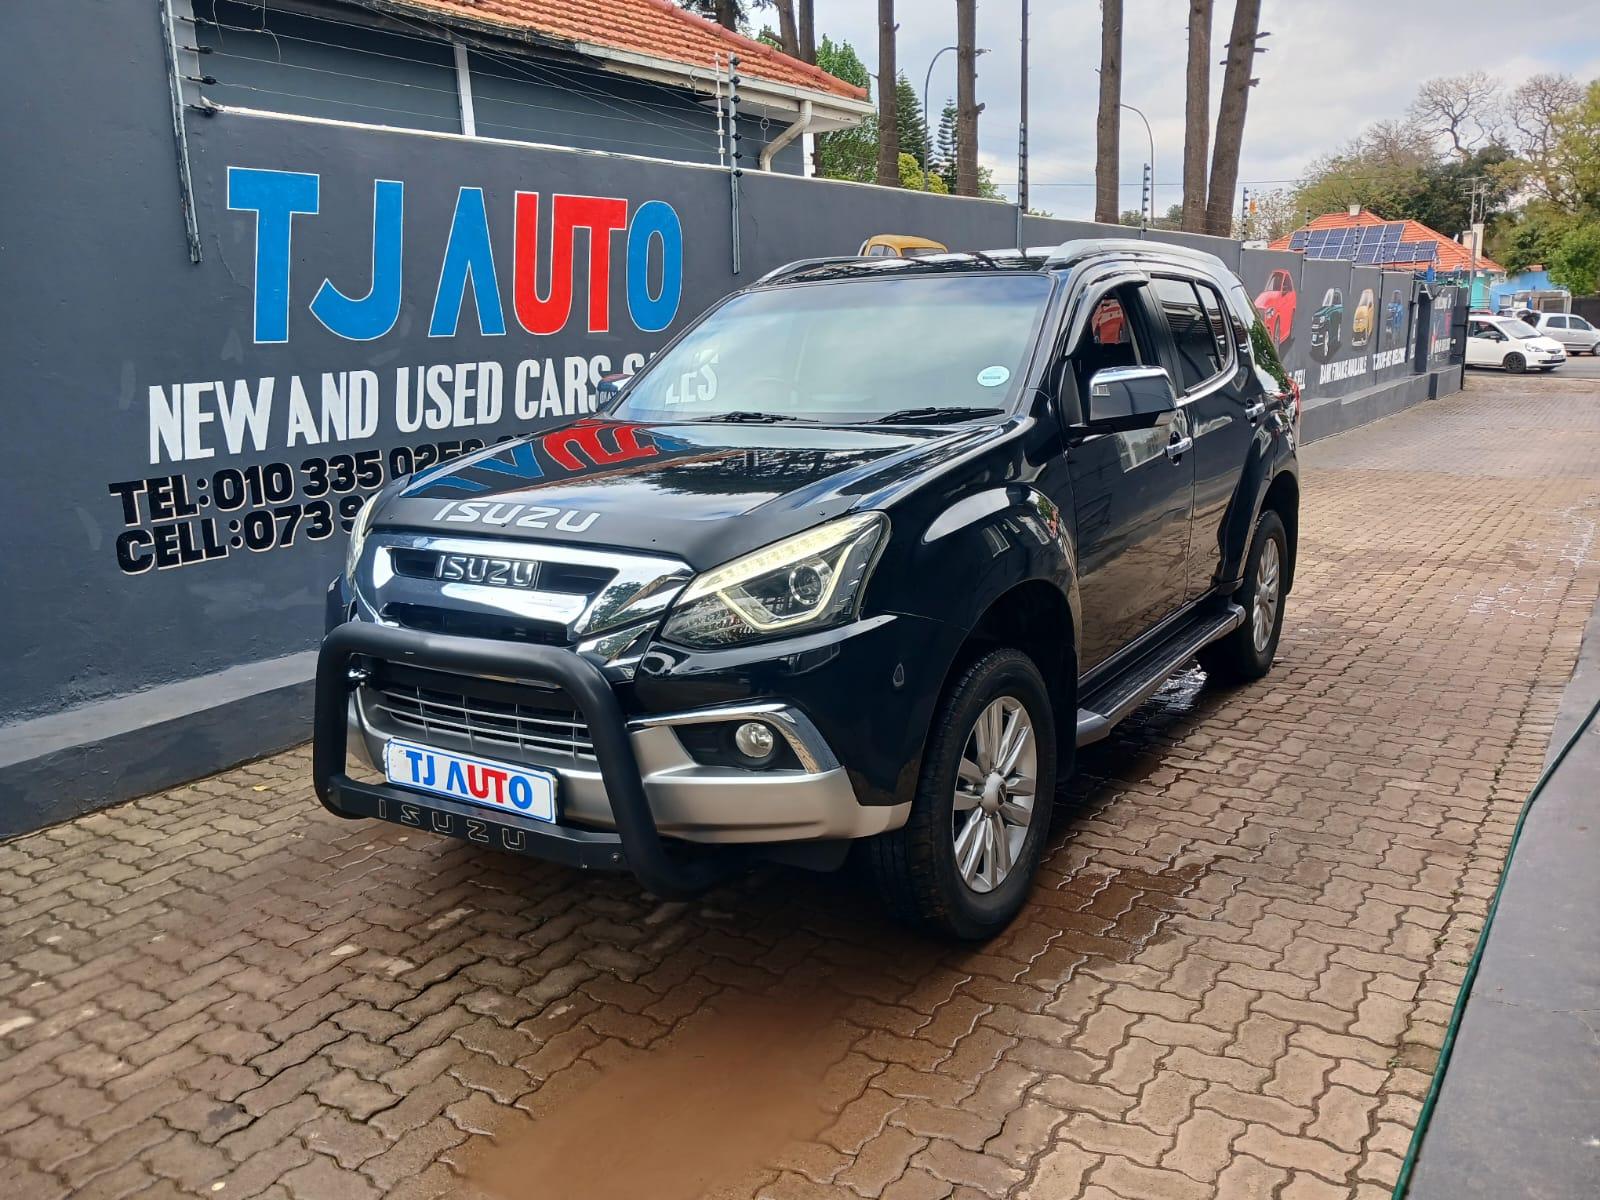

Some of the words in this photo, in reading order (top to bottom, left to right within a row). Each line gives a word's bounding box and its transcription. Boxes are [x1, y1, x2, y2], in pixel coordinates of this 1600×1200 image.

[226, 166, 404, 343] TJ
[428, 186, 683, 336] AUTO
[148, 376, 275, 465] NEW
[286, 369, 379, 448] AND
[396, 361, 503, 433] USED
[514, 355, 612, 421] CARS
[301, 450, 384, 498] 335
[433, 502, 600, 533] ISUZU
[436, 555, 535, 587] ISUZU
[405, 750, 436, 786] TJ
[446, 761, 532, 810] AUTO
[378, 799, 525, 850] ISUZU
